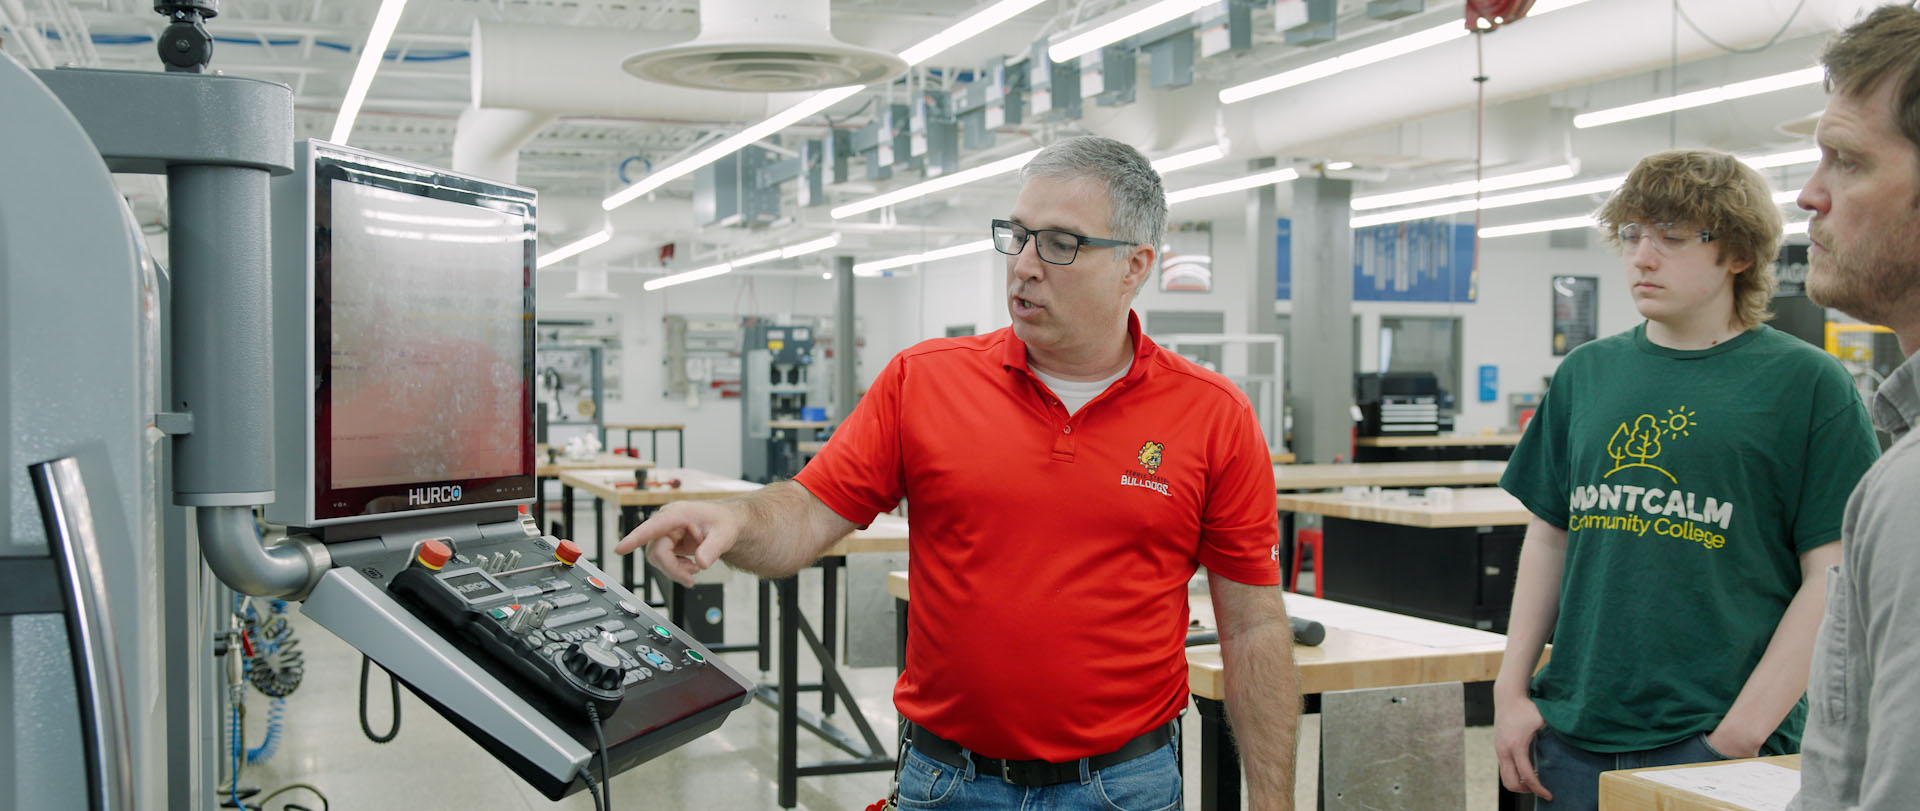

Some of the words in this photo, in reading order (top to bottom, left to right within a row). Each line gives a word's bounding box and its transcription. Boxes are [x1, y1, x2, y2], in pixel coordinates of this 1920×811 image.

[409, 485, 461, 505] HURCO
[1121, 475, 1168, 495] BULLDOGS
[1569, 484, 1733, 530] MONTCALM
[1654, 518, 1726, 549] College
